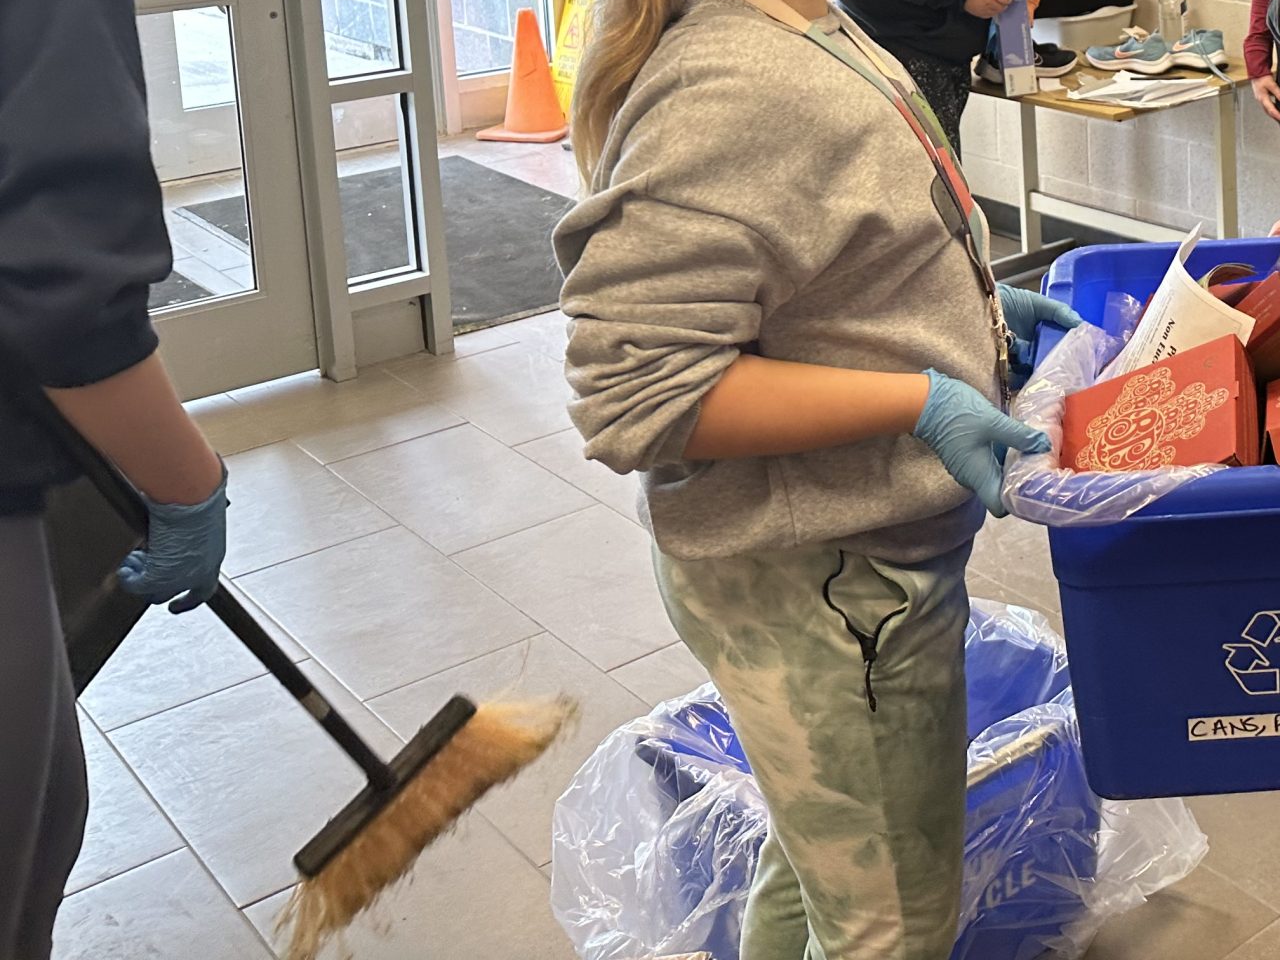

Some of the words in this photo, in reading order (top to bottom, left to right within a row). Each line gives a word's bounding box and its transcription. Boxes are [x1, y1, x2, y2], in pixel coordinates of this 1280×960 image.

[1162, 318, 1175, 340] Non
[1190, 717, 1266, 737] CANS,
[978, 858, 1037, 913] CLE
